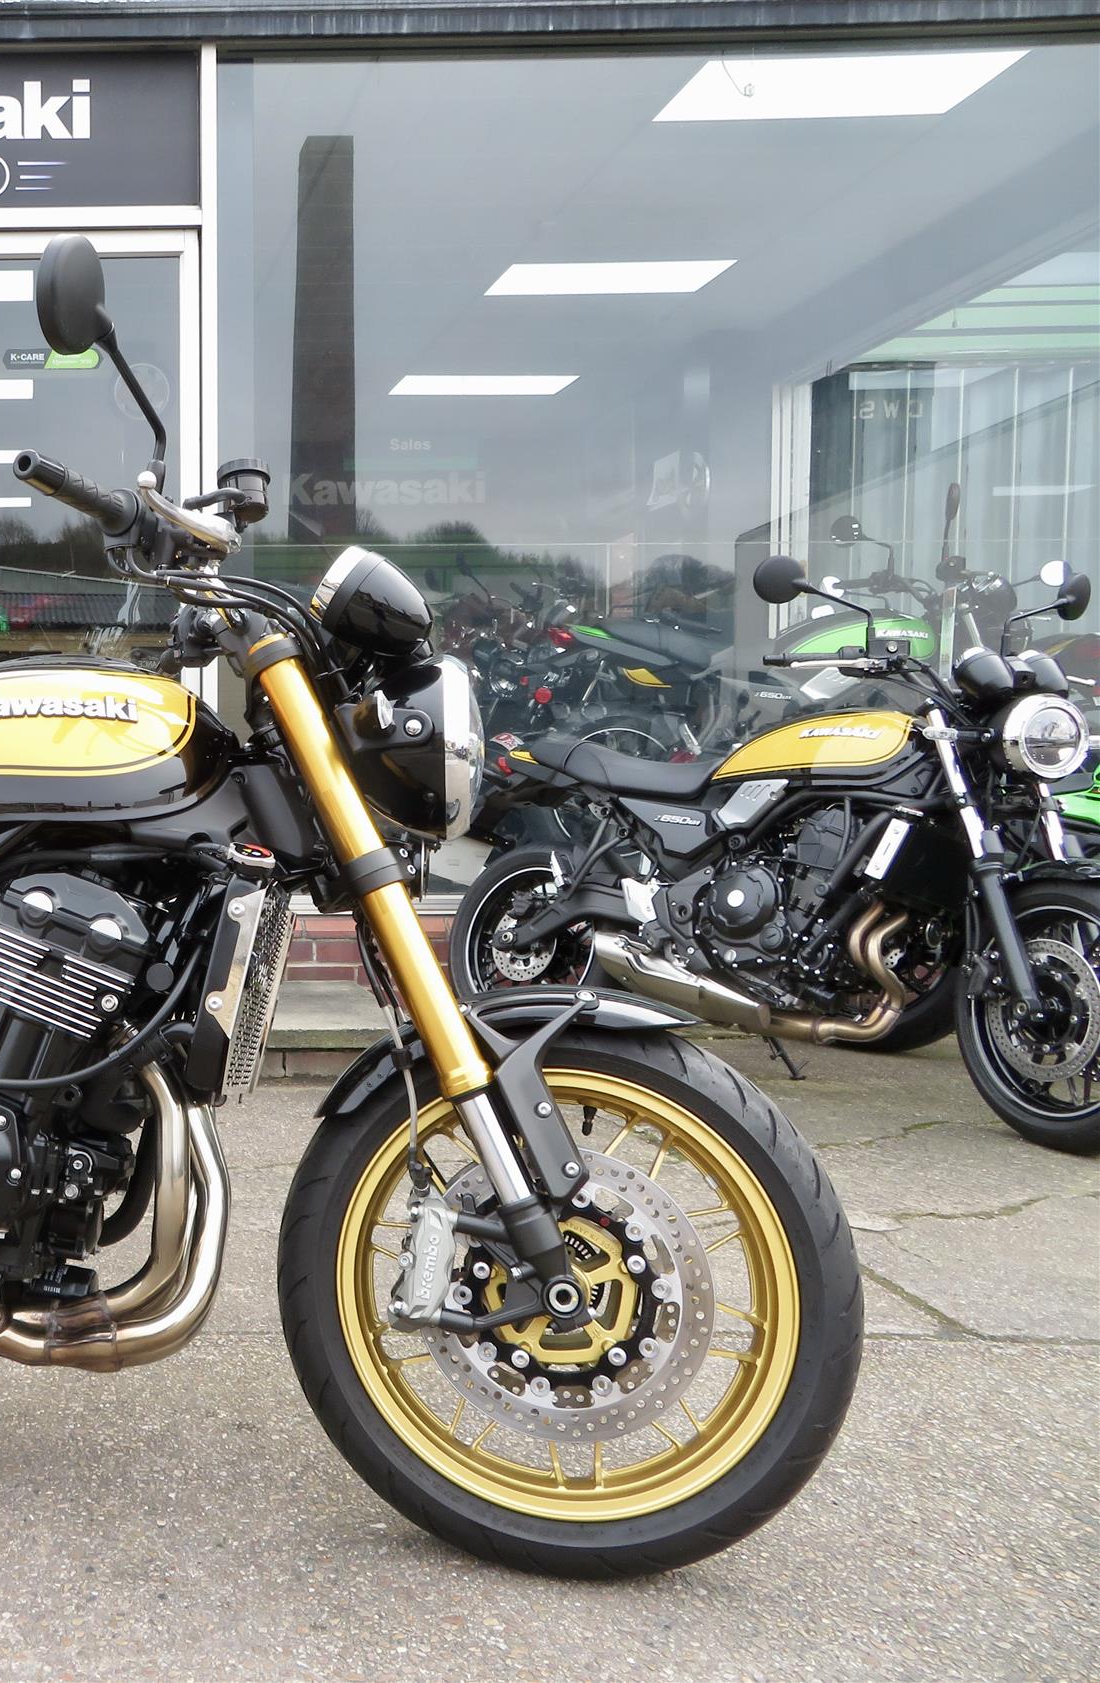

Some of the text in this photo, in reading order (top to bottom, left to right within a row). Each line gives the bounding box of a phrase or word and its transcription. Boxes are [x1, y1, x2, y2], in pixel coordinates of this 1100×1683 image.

[390, 438, 432, 450] Sales
[283, 471, 486, 506] Kawasaki
[875, 628, 929, 639] KAWASAKI
[799, 727, 884, 740] KAWASAKI
[415, 1233, 441, 1300] brembo
